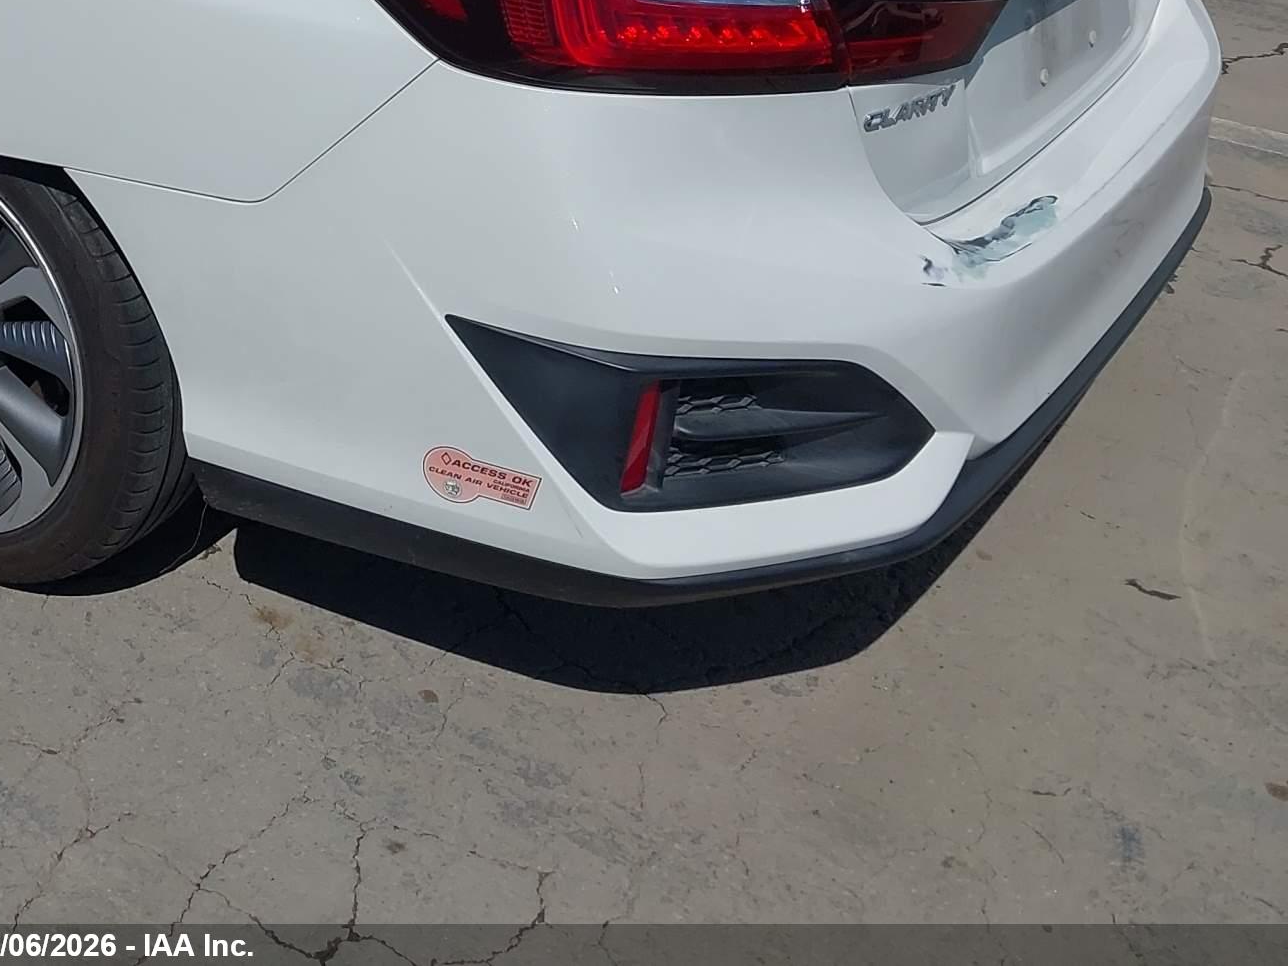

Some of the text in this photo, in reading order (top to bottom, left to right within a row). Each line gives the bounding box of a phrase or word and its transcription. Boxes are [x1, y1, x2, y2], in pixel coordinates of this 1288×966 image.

[863, 85, 955, 132] CLARITY
[428, 466, 529, 498] CLEAN AIR VEHICLE
[451, 459, 533, 487] ACCESS OK
[493, 479, 530, 493] CALIFORNIA
